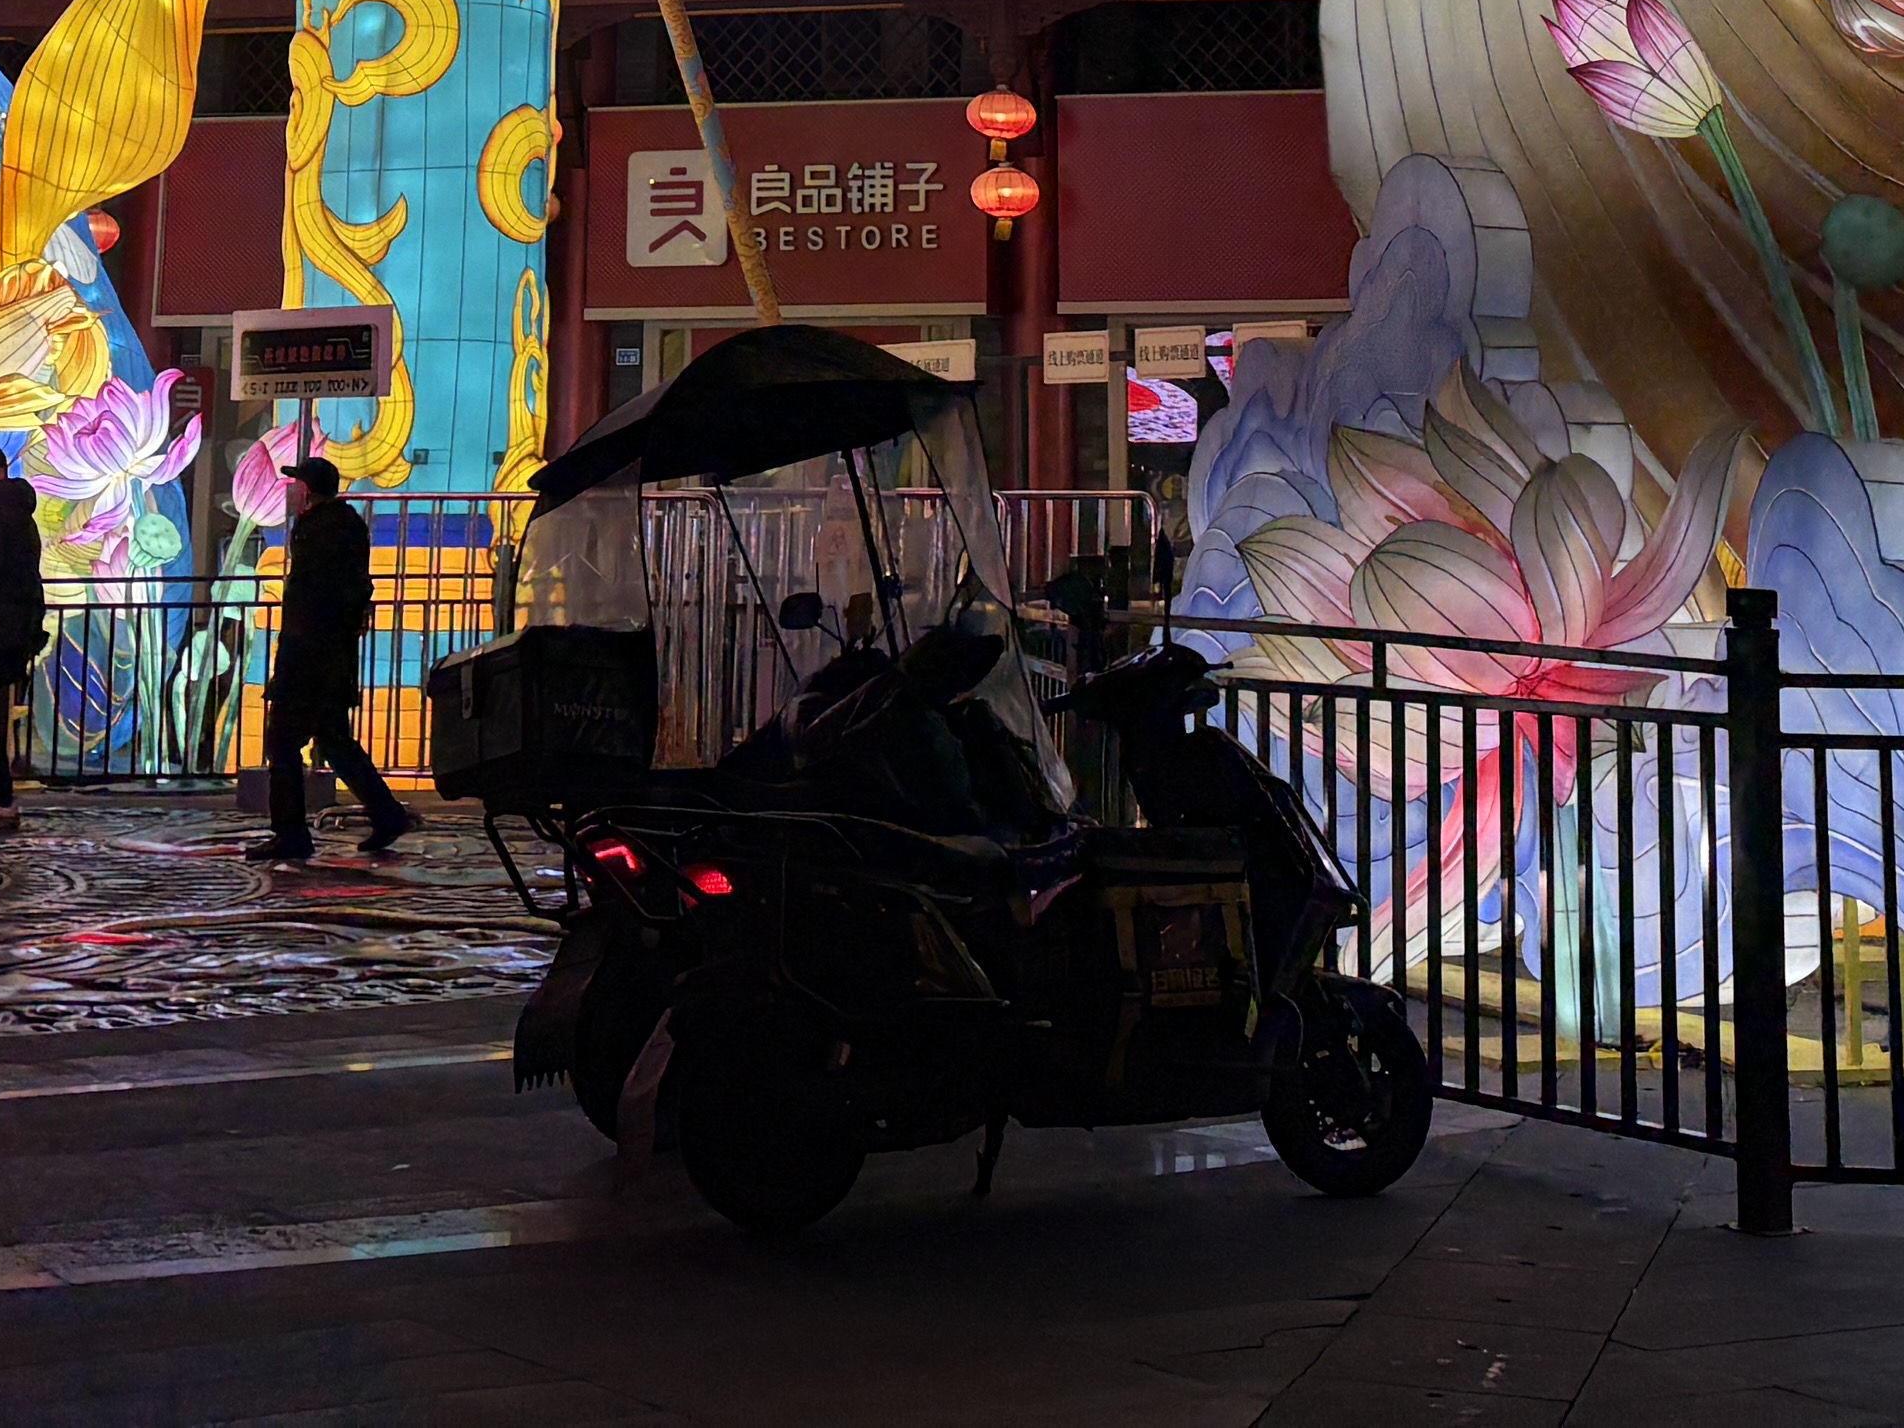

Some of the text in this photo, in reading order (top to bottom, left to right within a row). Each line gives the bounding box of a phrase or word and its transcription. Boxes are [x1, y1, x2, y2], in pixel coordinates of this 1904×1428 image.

[750, 161, 945, 217] 良品铺子
[752, 224, 940, 252] BESTORE
